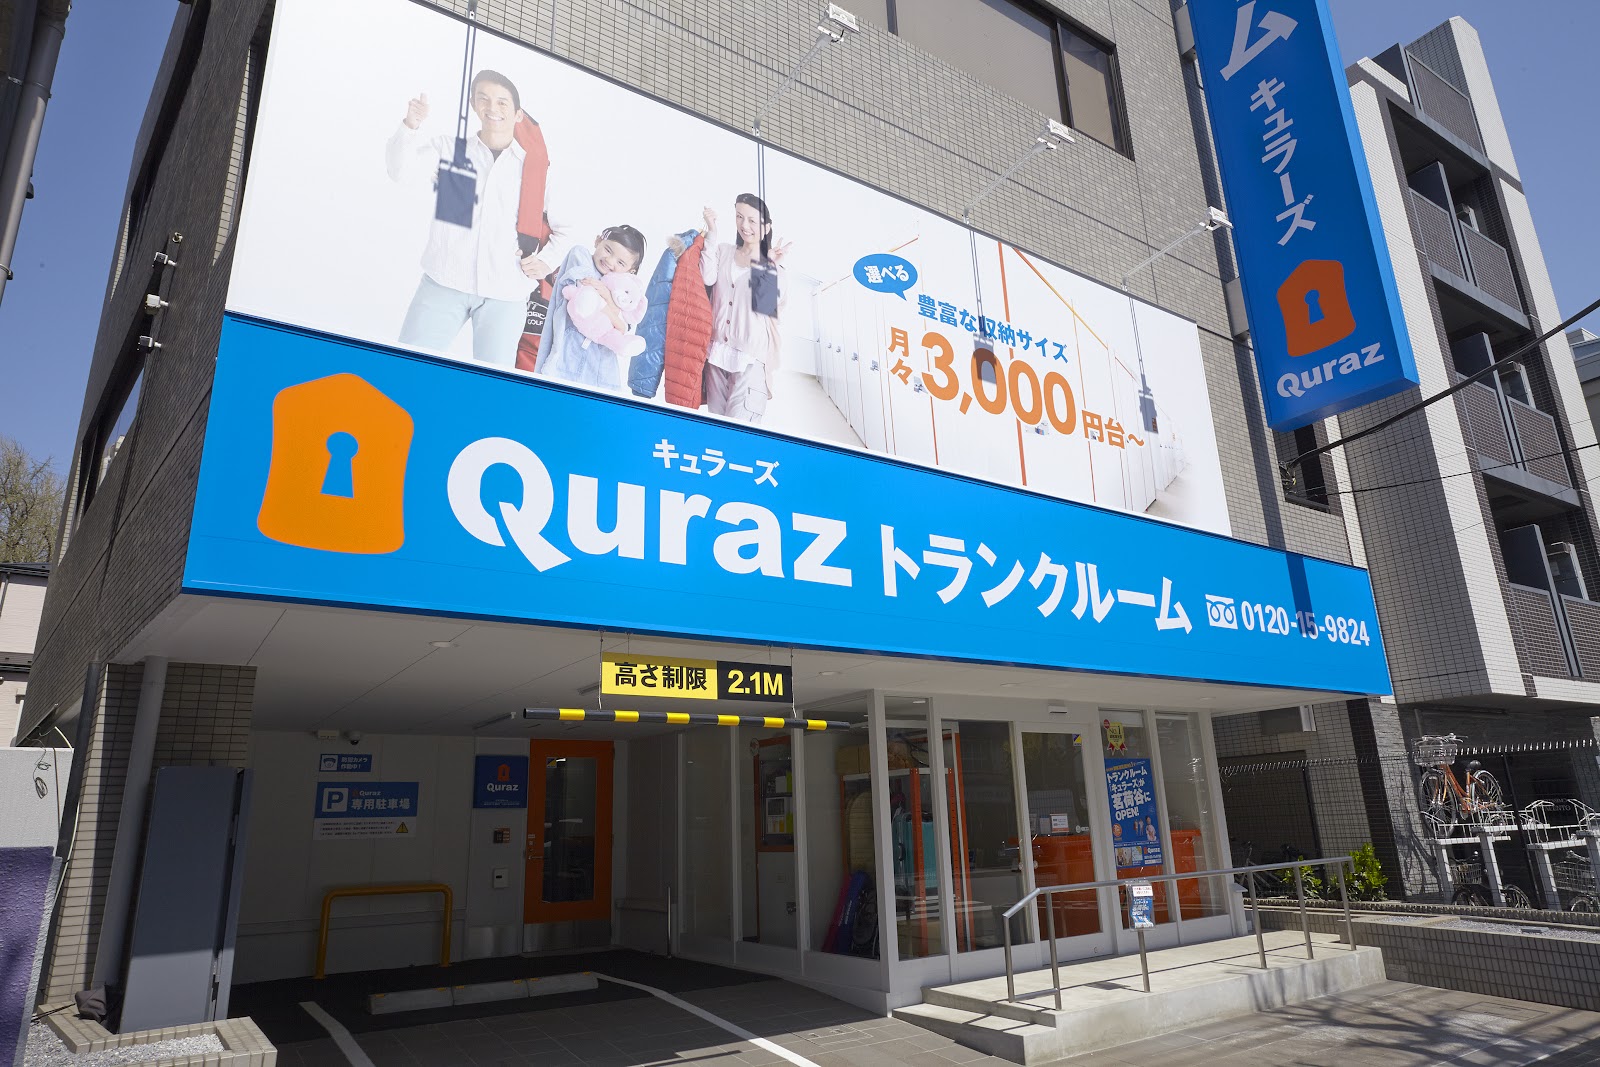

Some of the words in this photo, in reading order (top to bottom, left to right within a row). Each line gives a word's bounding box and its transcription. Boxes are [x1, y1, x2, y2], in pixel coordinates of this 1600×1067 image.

[1249, 77, 1317, 246] キュラーズ
[864, 265, 910, 283] 選べる
[917, 294, 1069, 364] 豊富な収納サイズ
[887, 326, 913, 386] 月々
[1276, 342, 1385, 398] Quraz
[652, 438, 780, 488] キュラーズ
[447, 436, 853, 588] Quraz
[880, 523, 1193, 635] トランクルーム
[1241, 600, 1371, 648] 0120-15-9824
[614, 661, 707, 691] 高さ制限
[727, 669, 784, 696] 2.1M
[486, 782, 520, 793] Quraz
[1106, 766, 1148, 783] トランクルーム
[326, 791, 344, 809] P
[351, 798, 411, 810] 専用駐車場
[1111, 788, 1152, 811] 茗荷谷に
[1115, 806, 1140, 822] OPEN!
